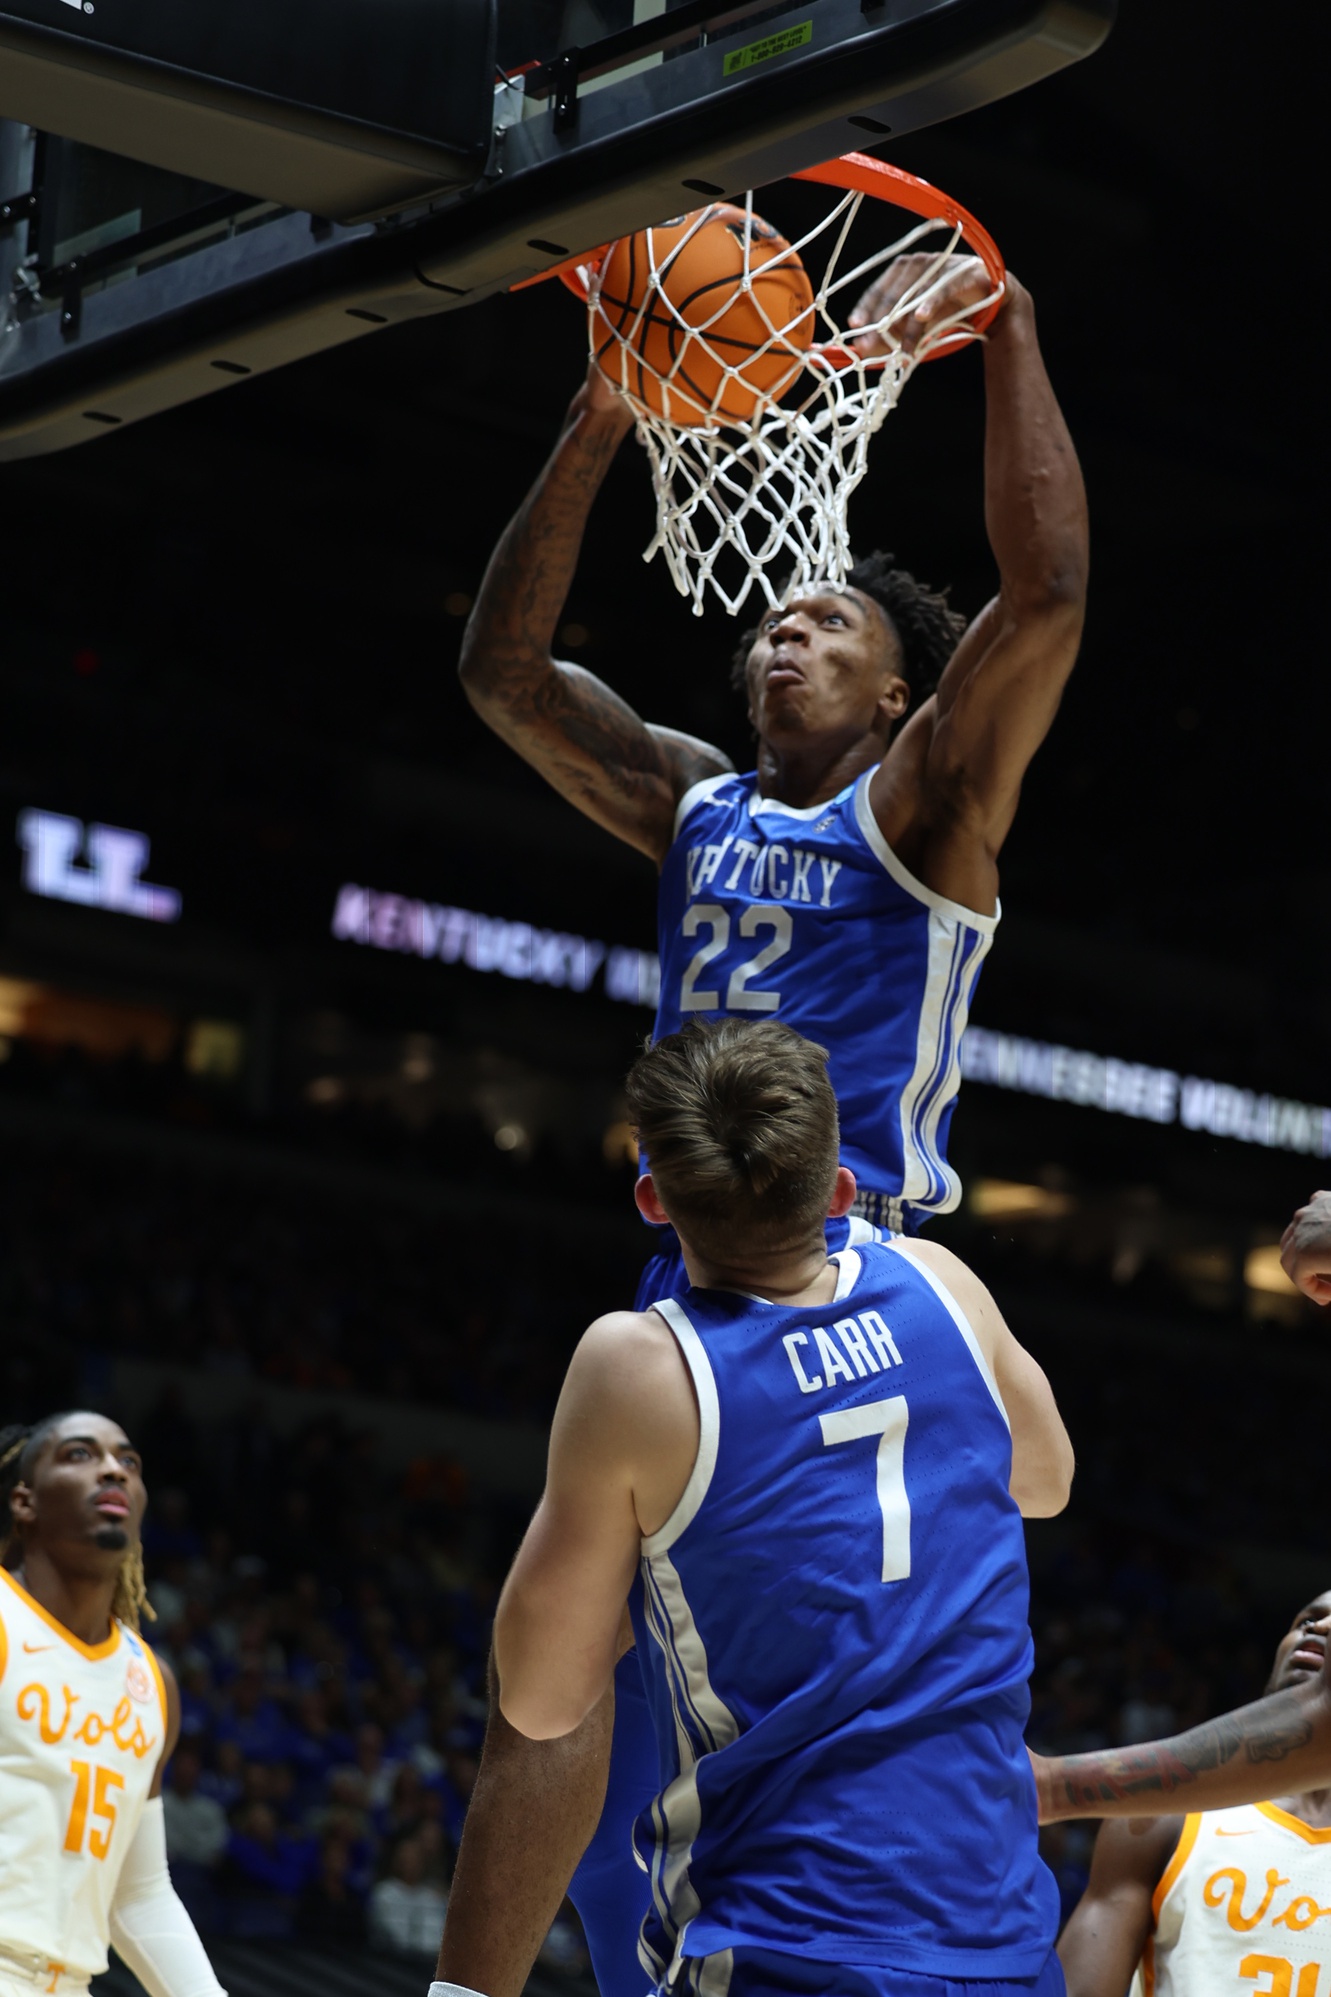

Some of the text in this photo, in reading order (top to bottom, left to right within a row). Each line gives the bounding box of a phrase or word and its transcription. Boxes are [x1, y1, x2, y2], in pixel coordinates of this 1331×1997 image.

[332, 883, 606, 992] KENTUCKY
[680, 904, 793, 1012] 22
[959, 1024, 1179, 1125] ENNESSEE
[782, 1310, 904, 1394] CARR
[818, 1395, 911, 1583] 7
[16, 1683, 156, 1759] Vols
[63, 1759, 125, 1861] 15
